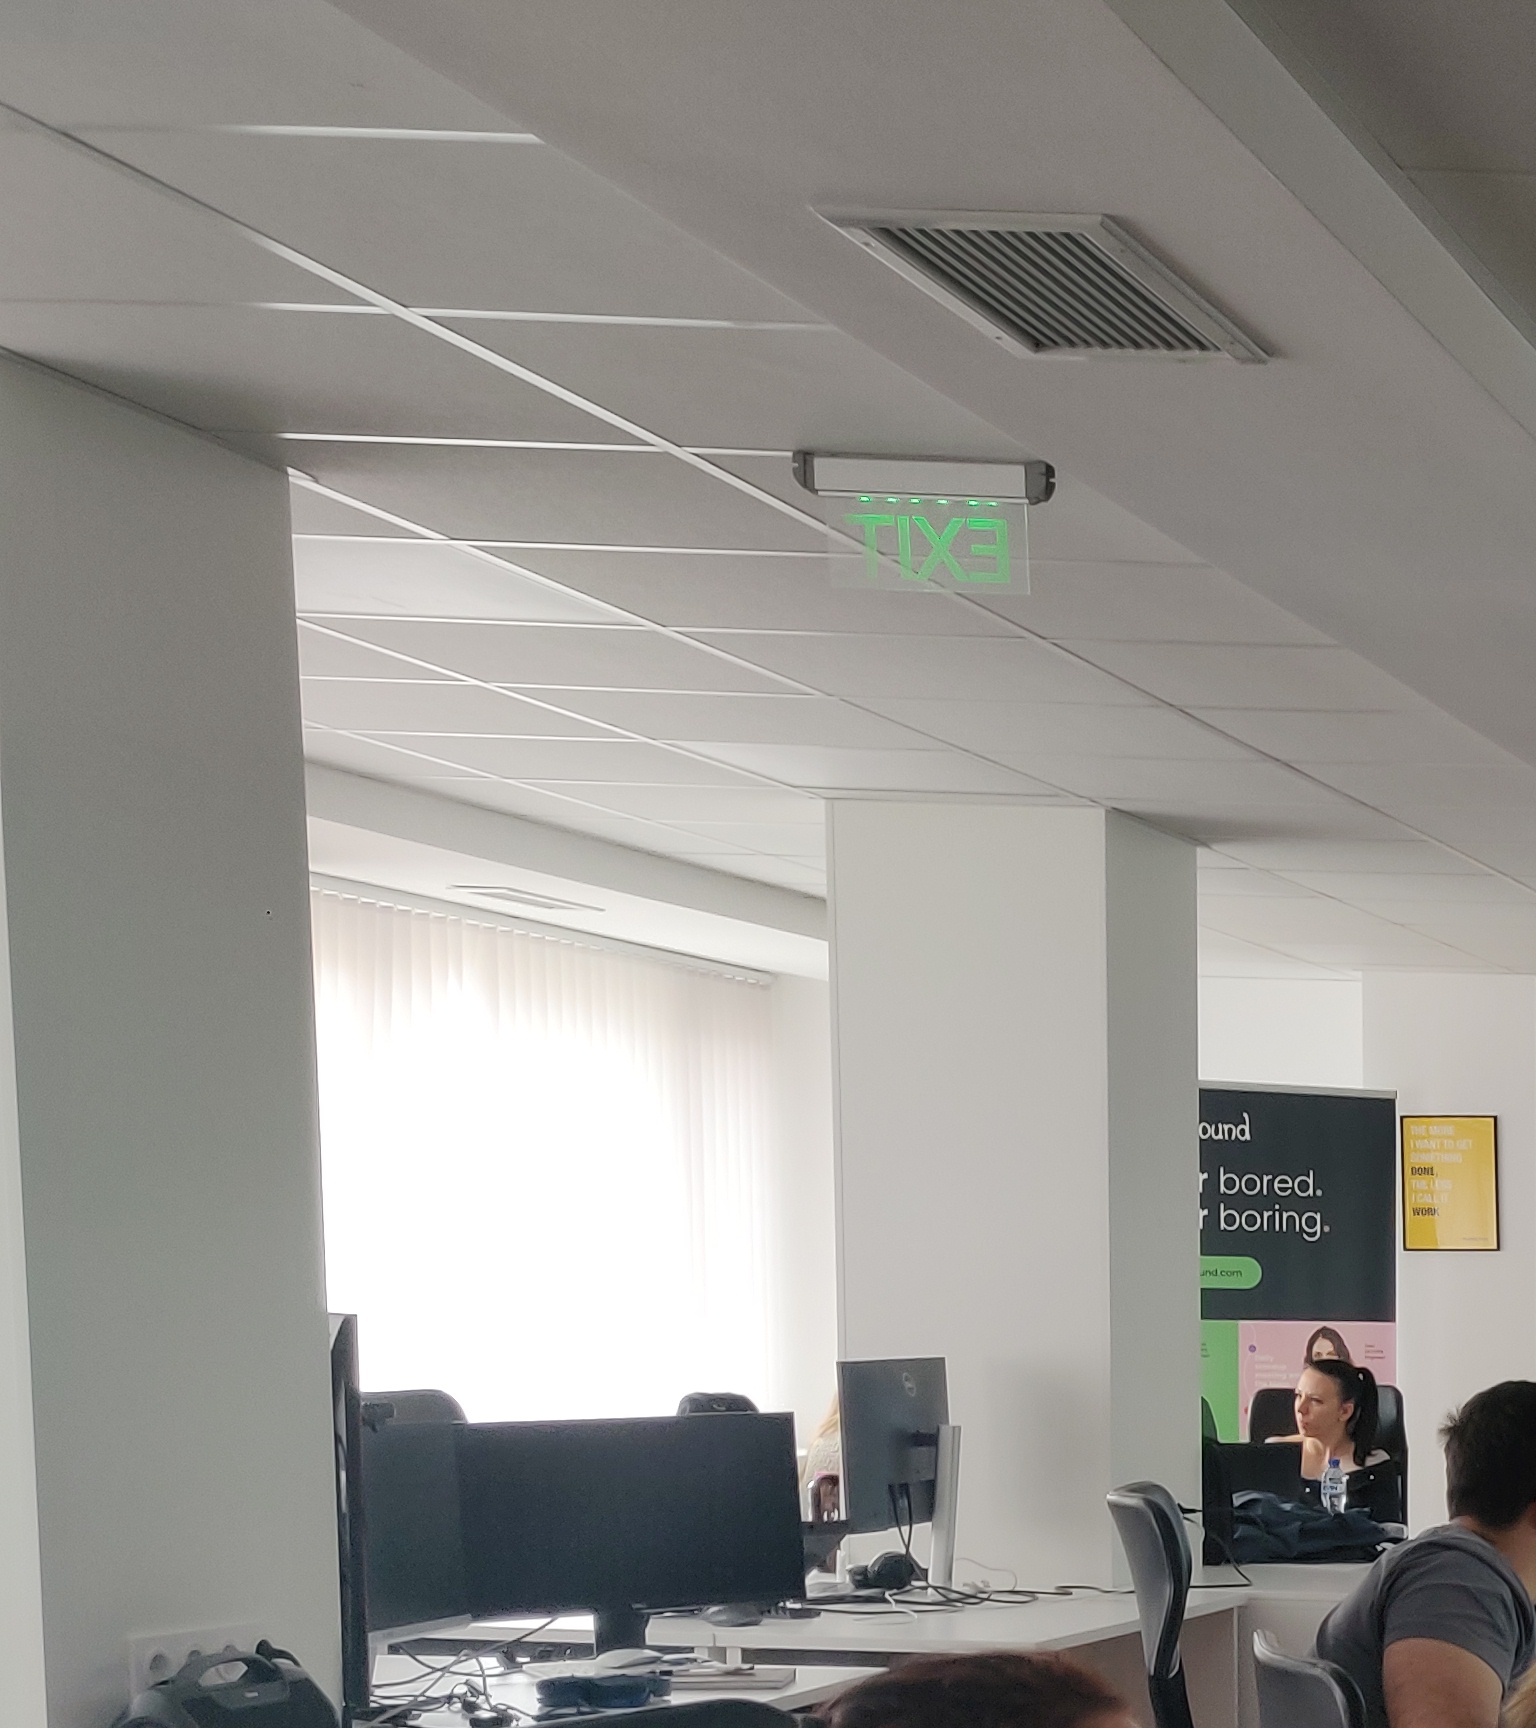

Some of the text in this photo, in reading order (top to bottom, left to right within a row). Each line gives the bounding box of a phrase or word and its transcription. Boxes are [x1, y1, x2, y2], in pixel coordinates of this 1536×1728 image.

[1199, 1111, 1251, 1141] ound
[1220, 1166, 1323, 1197] bored.
[1220, 1202, 1331, 1242] boring.
[1412, 1207, 1440, 1217] WORK
